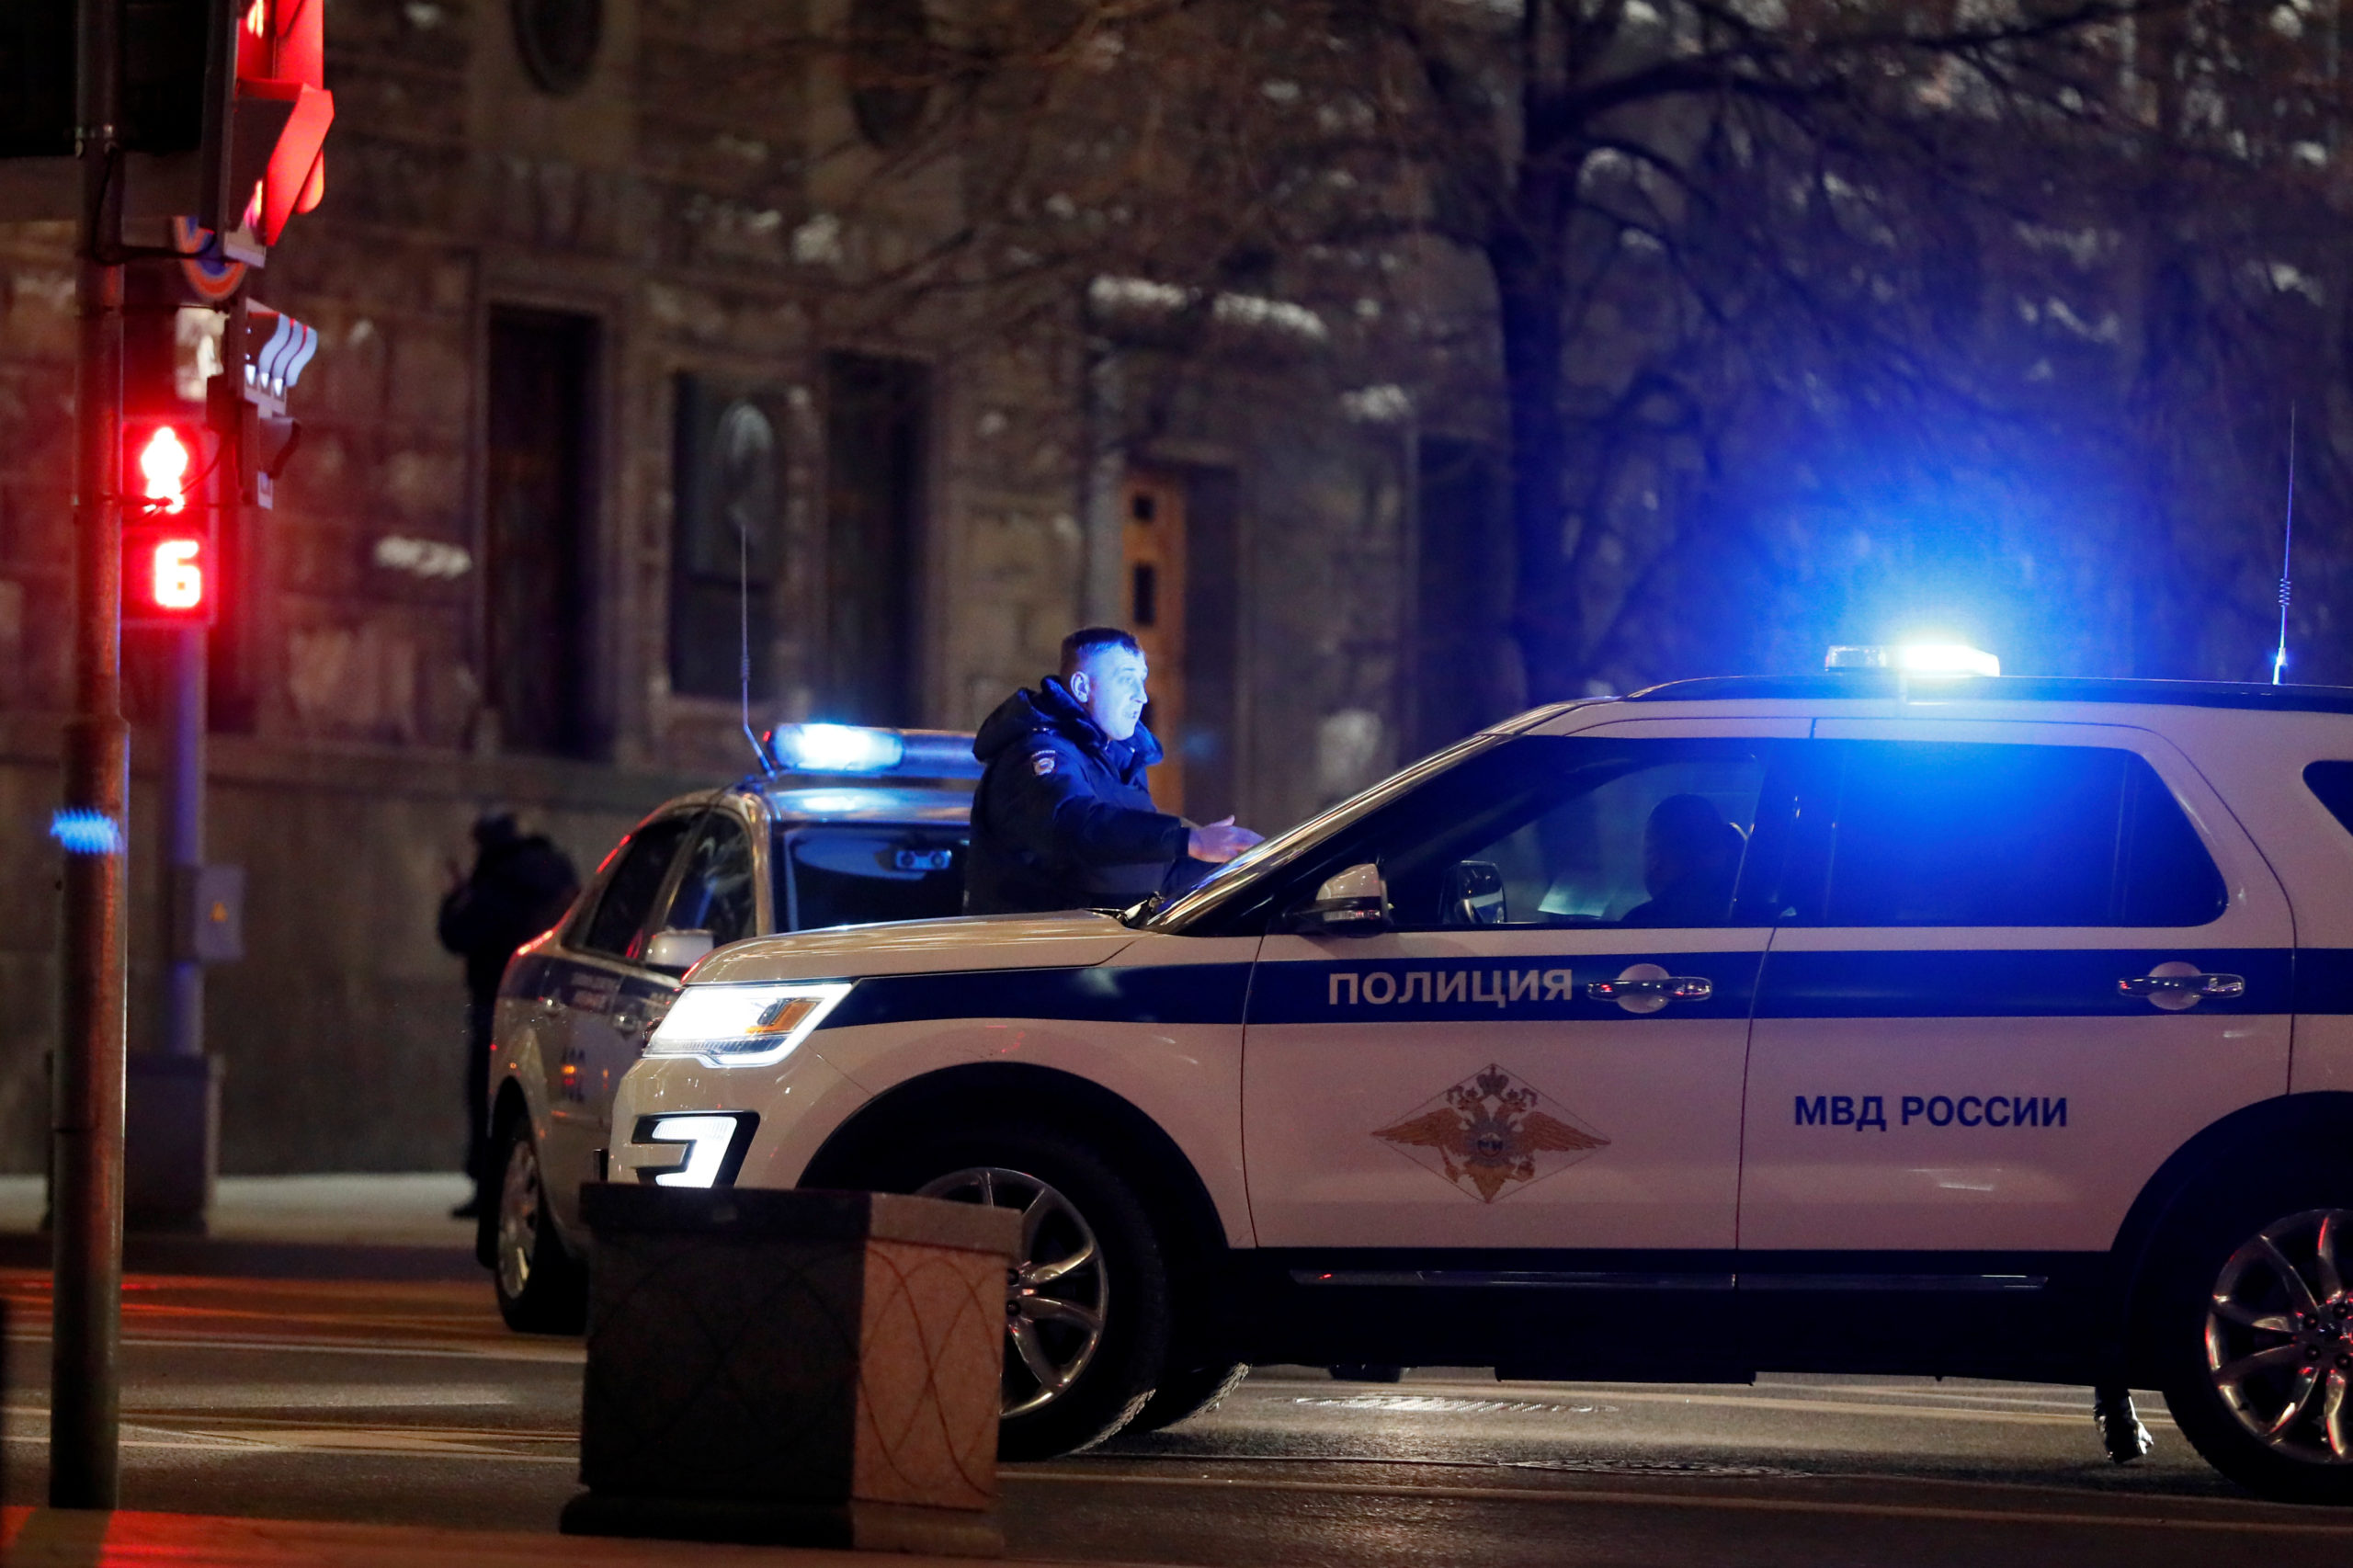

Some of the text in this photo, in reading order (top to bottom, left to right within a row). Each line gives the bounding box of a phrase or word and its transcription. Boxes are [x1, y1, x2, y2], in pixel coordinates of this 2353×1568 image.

[154, 540, 201, 608] 6
[1329, 969, 1573, 1008] ПОЛИЦИЯ
[1795, 1096, 2068, 1131] МВД РОССИИ
